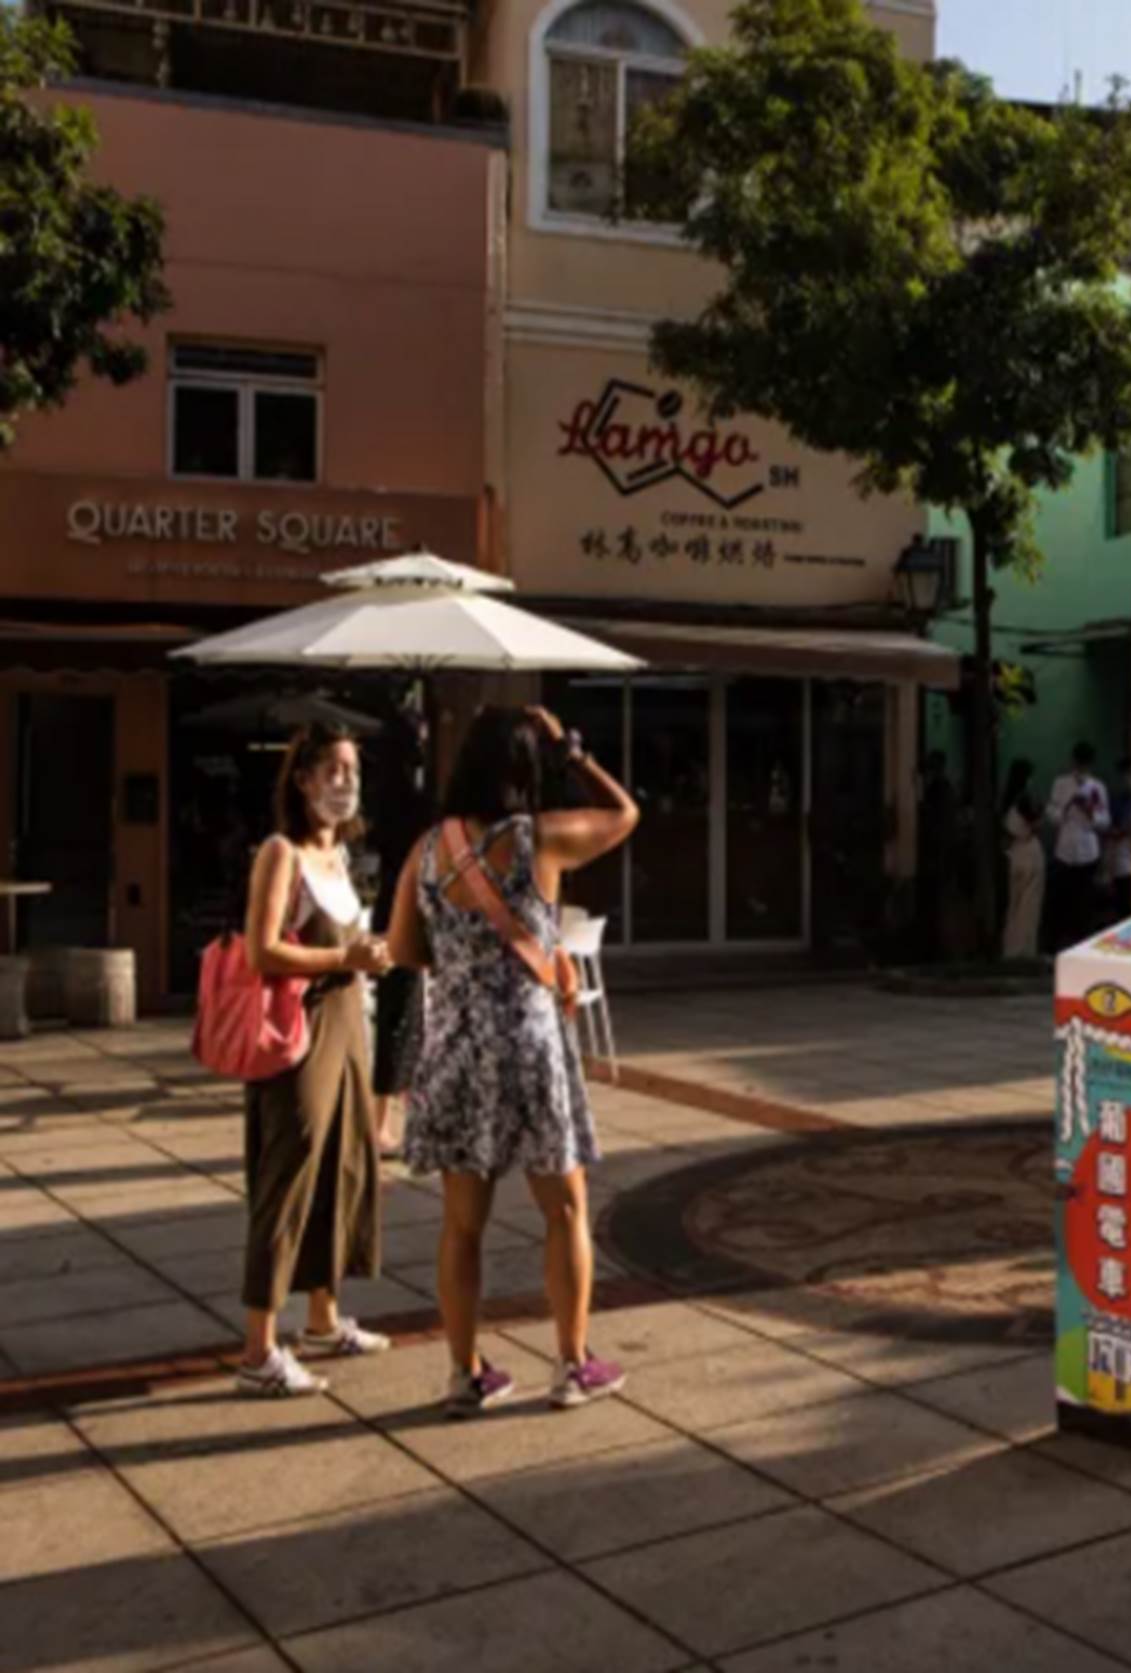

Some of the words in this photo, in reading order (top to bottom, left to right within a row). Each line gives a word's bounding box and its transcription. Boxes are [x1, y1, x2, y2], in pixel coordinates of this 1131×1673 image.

[768, 466, 800, 488] SH
[67, 501, 238, 543] QUARTER
[257, 511, 401, 553] SQUARE
